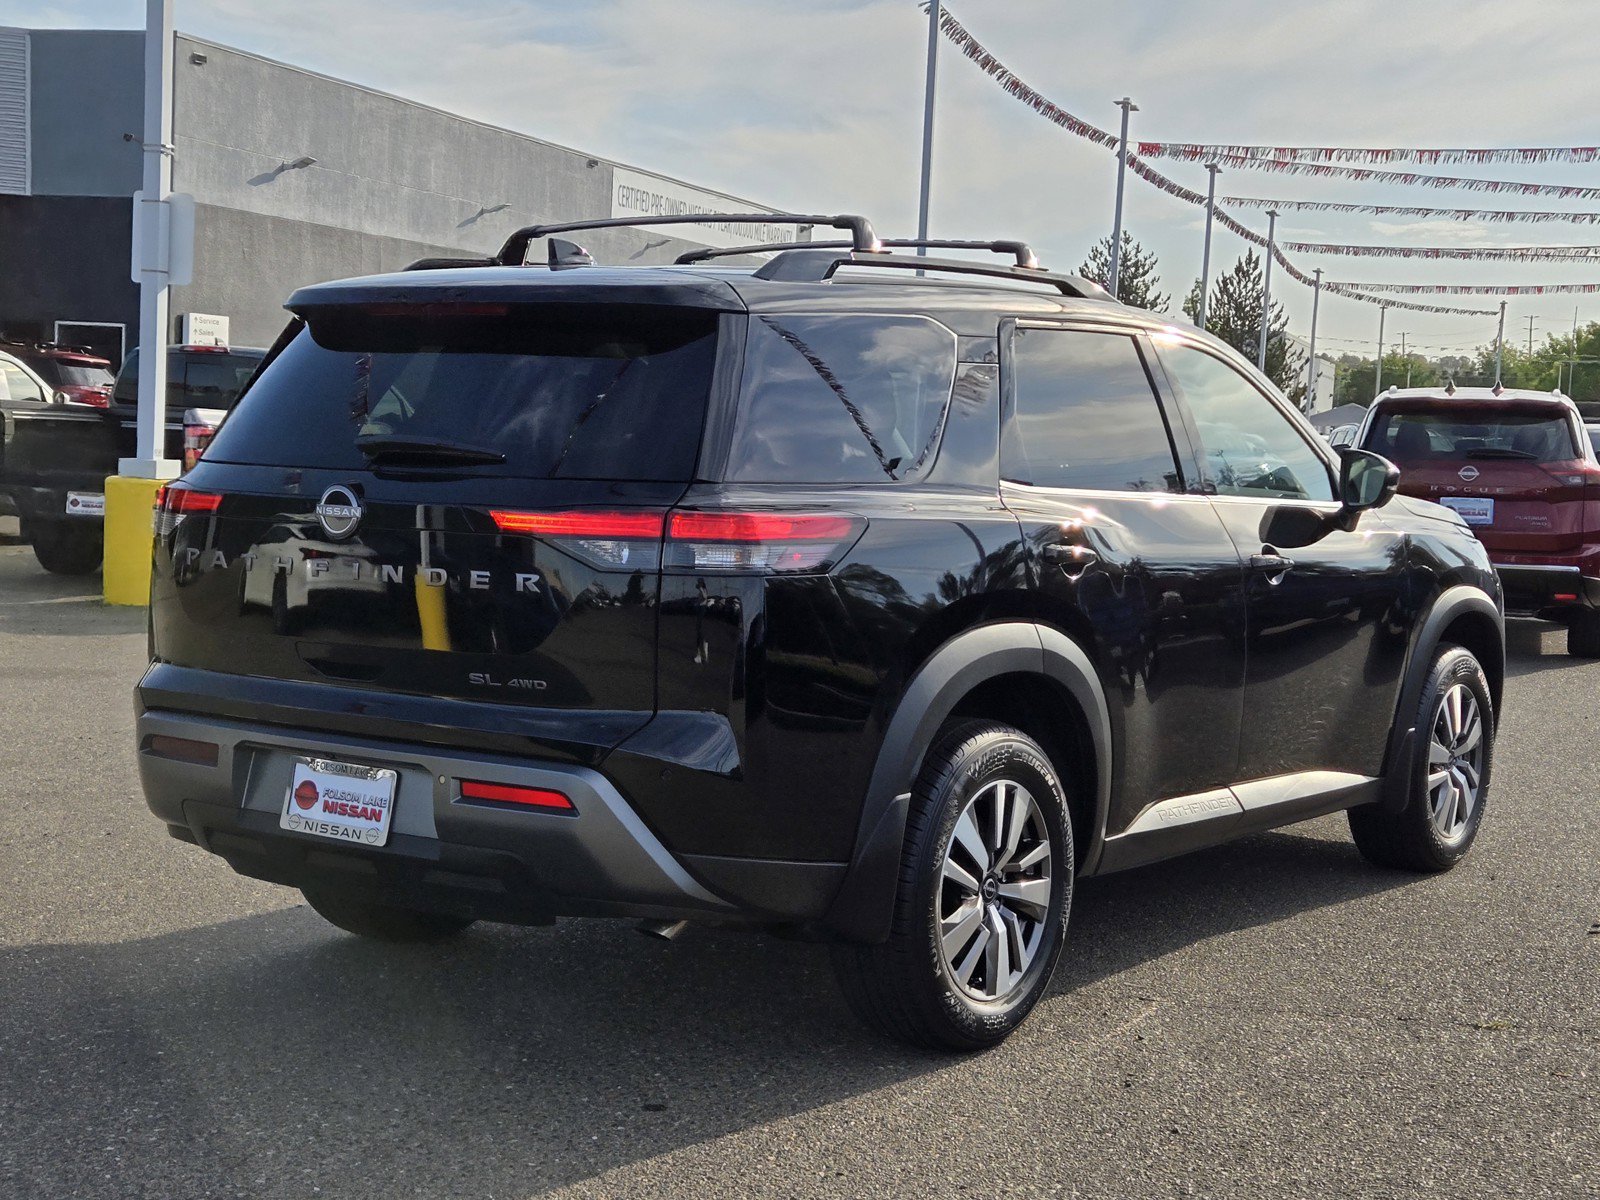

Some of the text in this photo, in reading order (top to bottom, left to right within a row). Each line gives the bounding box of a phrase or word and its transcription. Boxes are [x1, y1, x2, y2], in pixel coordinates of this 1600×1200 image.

[618, 184, 650, 213] CERTIFIED
[651, 193, 687, 216] PRE-OWNED
[199, 316, 220, 326] Service
[199, 329, 214, 337] Sales
[1430, 485, 1504, 494] ROGUE
[316, 505, 361, 518] NISSAN
[186, 547, 541, 594] PATHFINDER
[468, 672, 547, 690] SL 4WD
[315, 761, 348, 774] FOLSOM
[322, 787, 388, 809] FOLSOM LAKE
[322, 799, 384, 823] NISSAN
[1156, 796, 1237, 822] PATHFINDER
[303, 820, 362, 840] NISSAN
